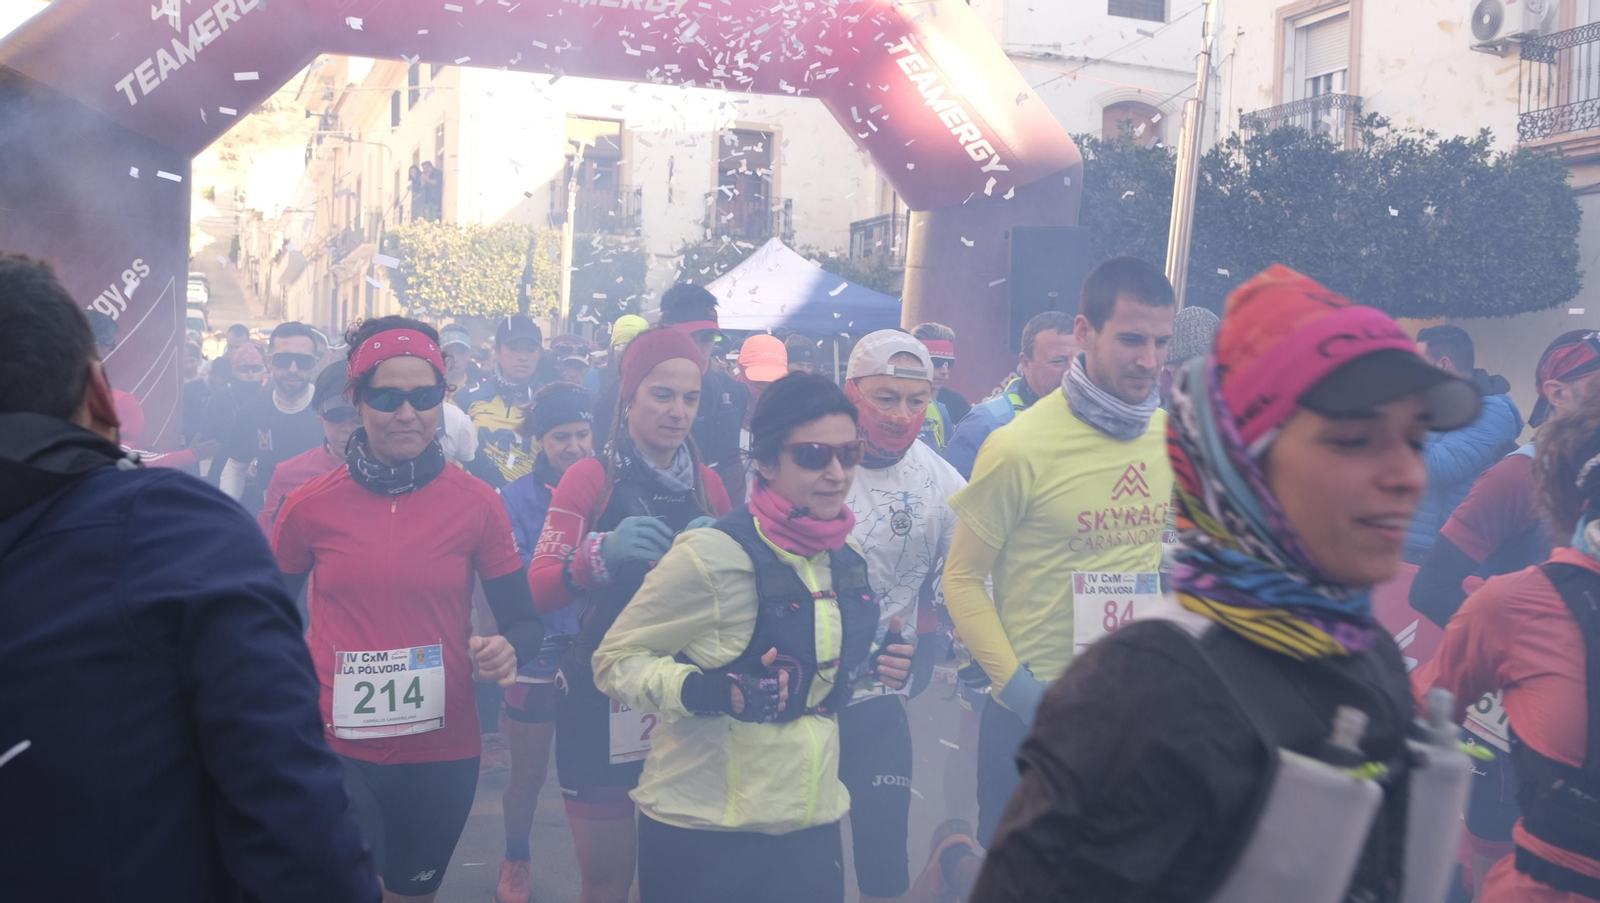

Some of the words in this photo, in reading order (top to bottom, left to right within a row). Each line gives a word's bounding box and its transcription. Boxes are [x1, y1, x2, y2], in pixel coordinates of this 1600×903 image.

[887, 35, 1010, 173] TEAMERGY
[1068, 533, 1122, 552] CARAS
[1127, 528, 1162, 546] NORT
[1088, 573, 1098, 583] IV
[1101, 573, 1121, 583] CxM
[1085, 586, 1096, 594] LA
[1102, 600, 1135, 633] 84
[346, 653, 358, 663] IV
[361, 652, 388, 663] CxM
[343, 666, 355, 675] LA
[358, 663, 407, 675] PÓLVORA
[353, 676, 424, 714] 214
[871, 774, 911, 788] Jom
